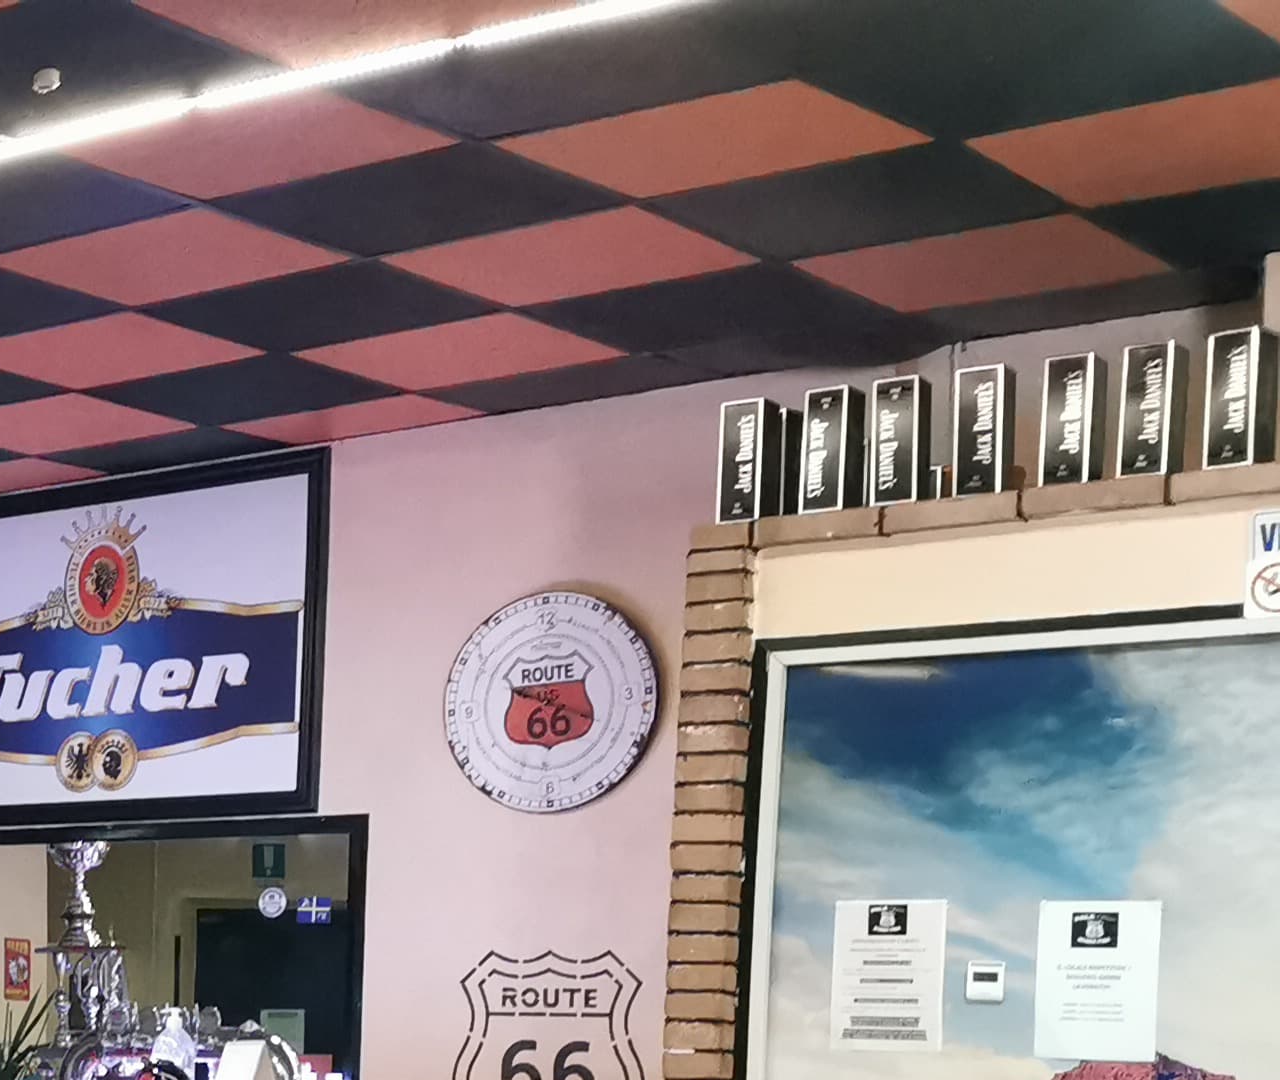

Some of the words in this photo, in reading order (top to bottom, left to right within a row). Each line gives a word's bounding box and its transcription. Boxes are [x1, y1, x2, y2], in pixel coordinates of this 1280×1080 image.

[1140, 358, 1163, 410] DANIEL'S
[972, 381, 994, 432] DANIEL'S
[1223, 400, 1246, 433] JACK
[735, 414, 755, 462] DANIEL'S
[810, 418, 829, 450] JACK
[880, 409, 899, 440] JACK
[1059, 421, 1081, 454] JACK
[1138, 411, 1160, 444] JACK
[972, 433, 992, 465] JACK
[734, 463, 753, 494] JACK
[807, 450, 828, 499] DANIEL'S
[878, 441, 899, 491] DANIEL'S
[1260, 522, 1280, 552] V
[521, 662, 575, 684] ROUTE
[526, 705, 571, 740] 66
[502, 987, 598, 1008] ROUTE
